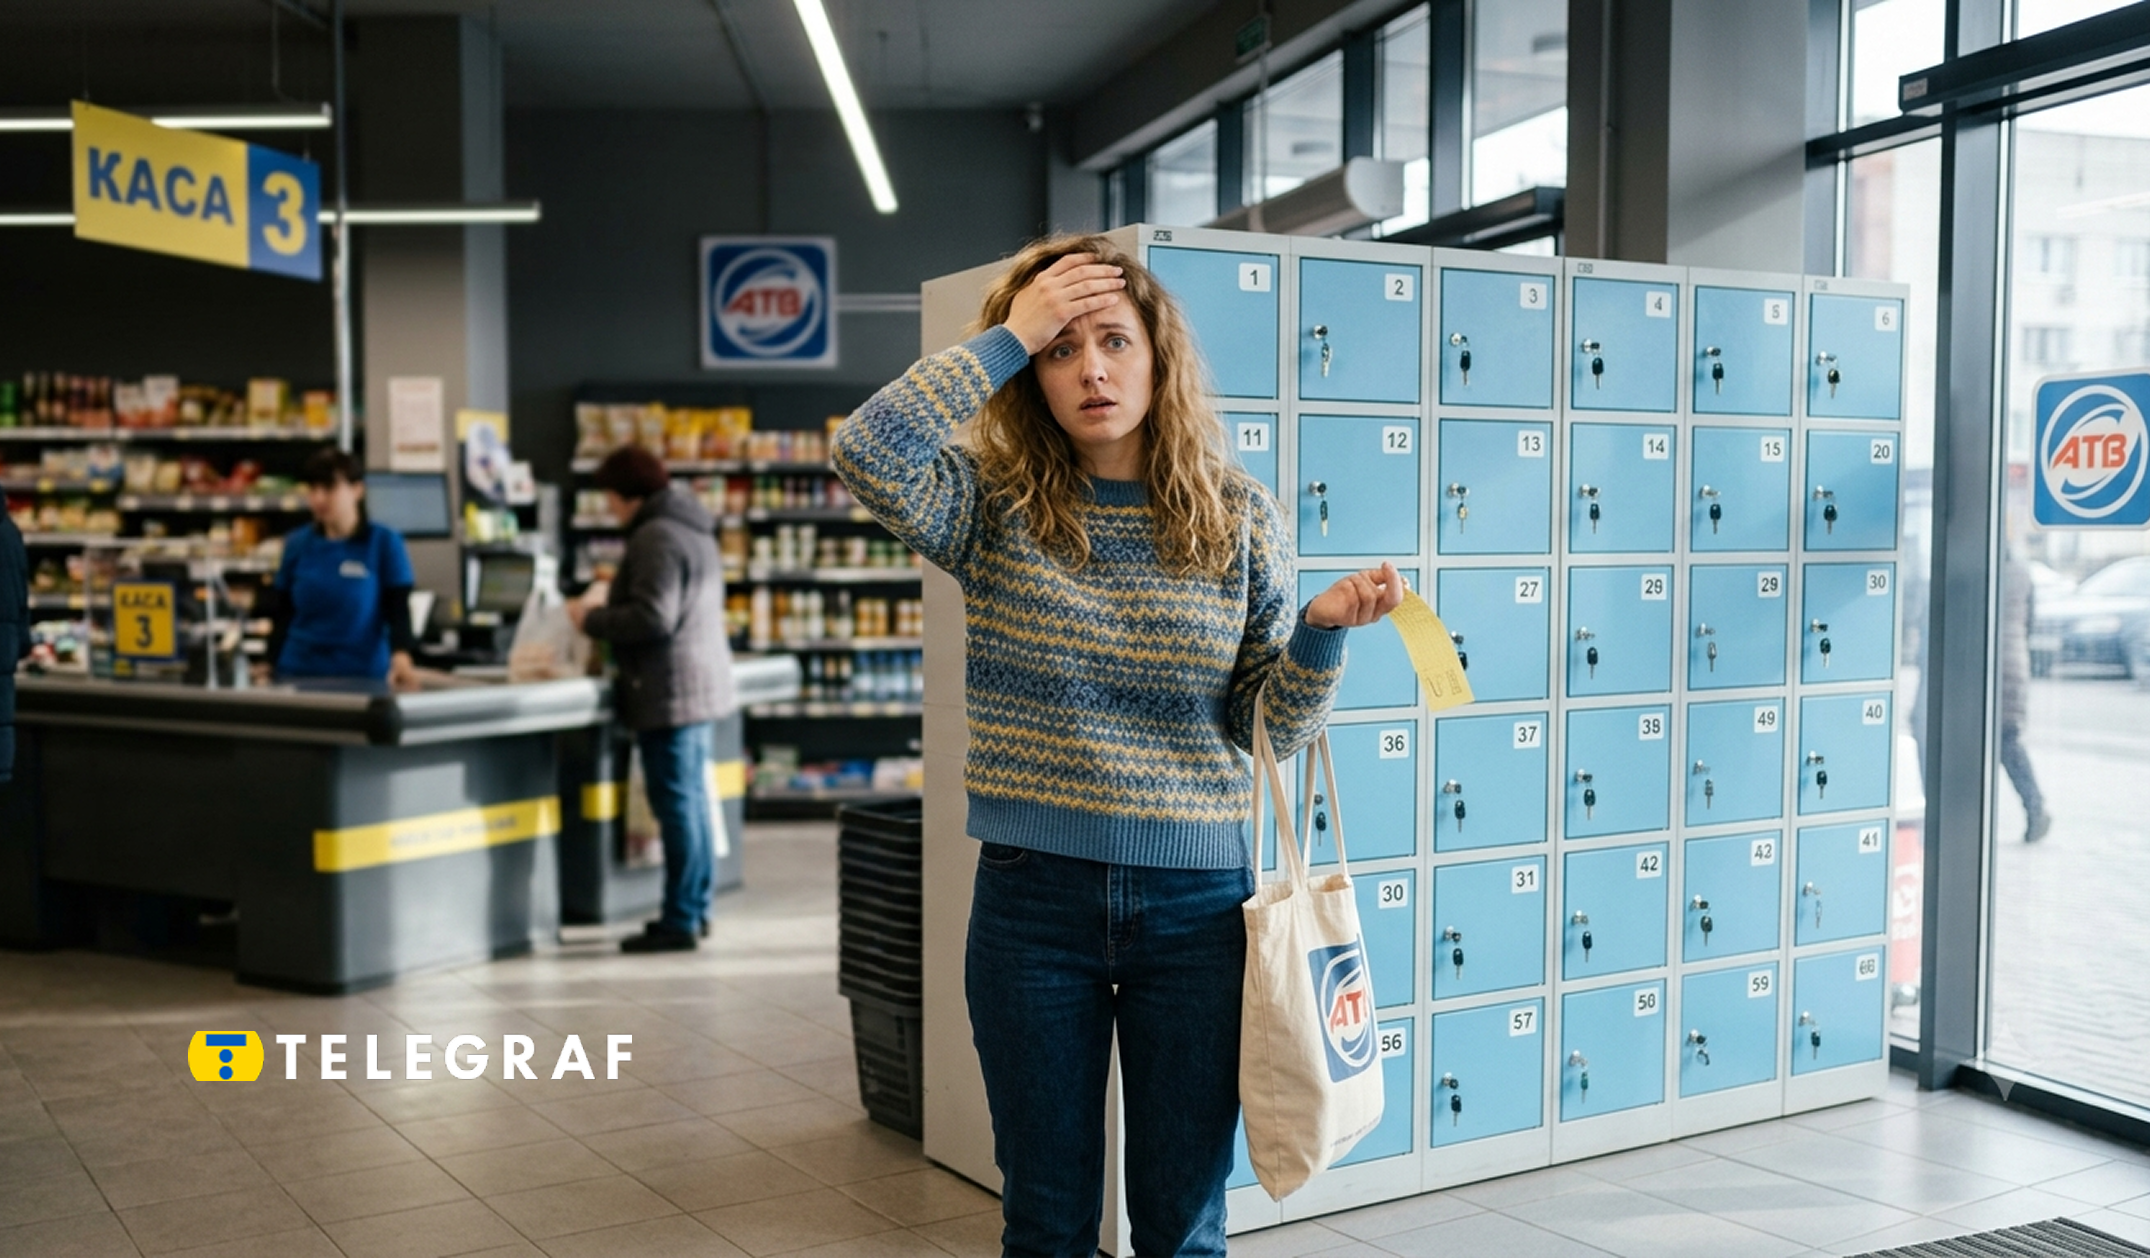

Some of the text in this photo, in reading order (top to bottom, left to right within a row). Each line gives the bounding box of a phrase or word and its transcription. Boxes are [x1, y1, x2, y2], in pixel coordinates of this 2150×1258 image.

[88, 146, 307, 256] КАСА 3
[1248, 269, 1258, 286] 1
[1394, 278, 1405, 296] 2
[1529, 287, 1539, 304] 3
[1653, 296, 1663, 312] 4
[1881, 311, 1890, 327] 6
[1243, 428, 1261, 446] 11
[1387, 431, 1408, 449] 12
[1522, 435, 1541, 452] 13
[1648, 438, 1665, 454] 14
[1764, 441, 1781, 457] 15
[1873, 443, 1890, 460] 20
[1519, 581, 1539, 598] 27
[1761, 576, 1779, 593] 29
[1869, 574, 1887, 590] 30
[135, 614, 153, 649] 3
[1757, 710, 1776, 726] 49
[1865, 704, 1883, 719] 40
[1517, 725, 1538, 743] 37
[1384, 734, 1405, 753] 36
[1861, 832, 1878, 847] 41
[1640, 855, 1658, 872] 42
[1516, 870, 1534, 888] 31
[1382, 883, 1404, 903] 30
[1752, 975, 1769, 993] 59
[1513, 1011, 1533, 1030] 57
[1381, 1033, 1402, 1053] 56
